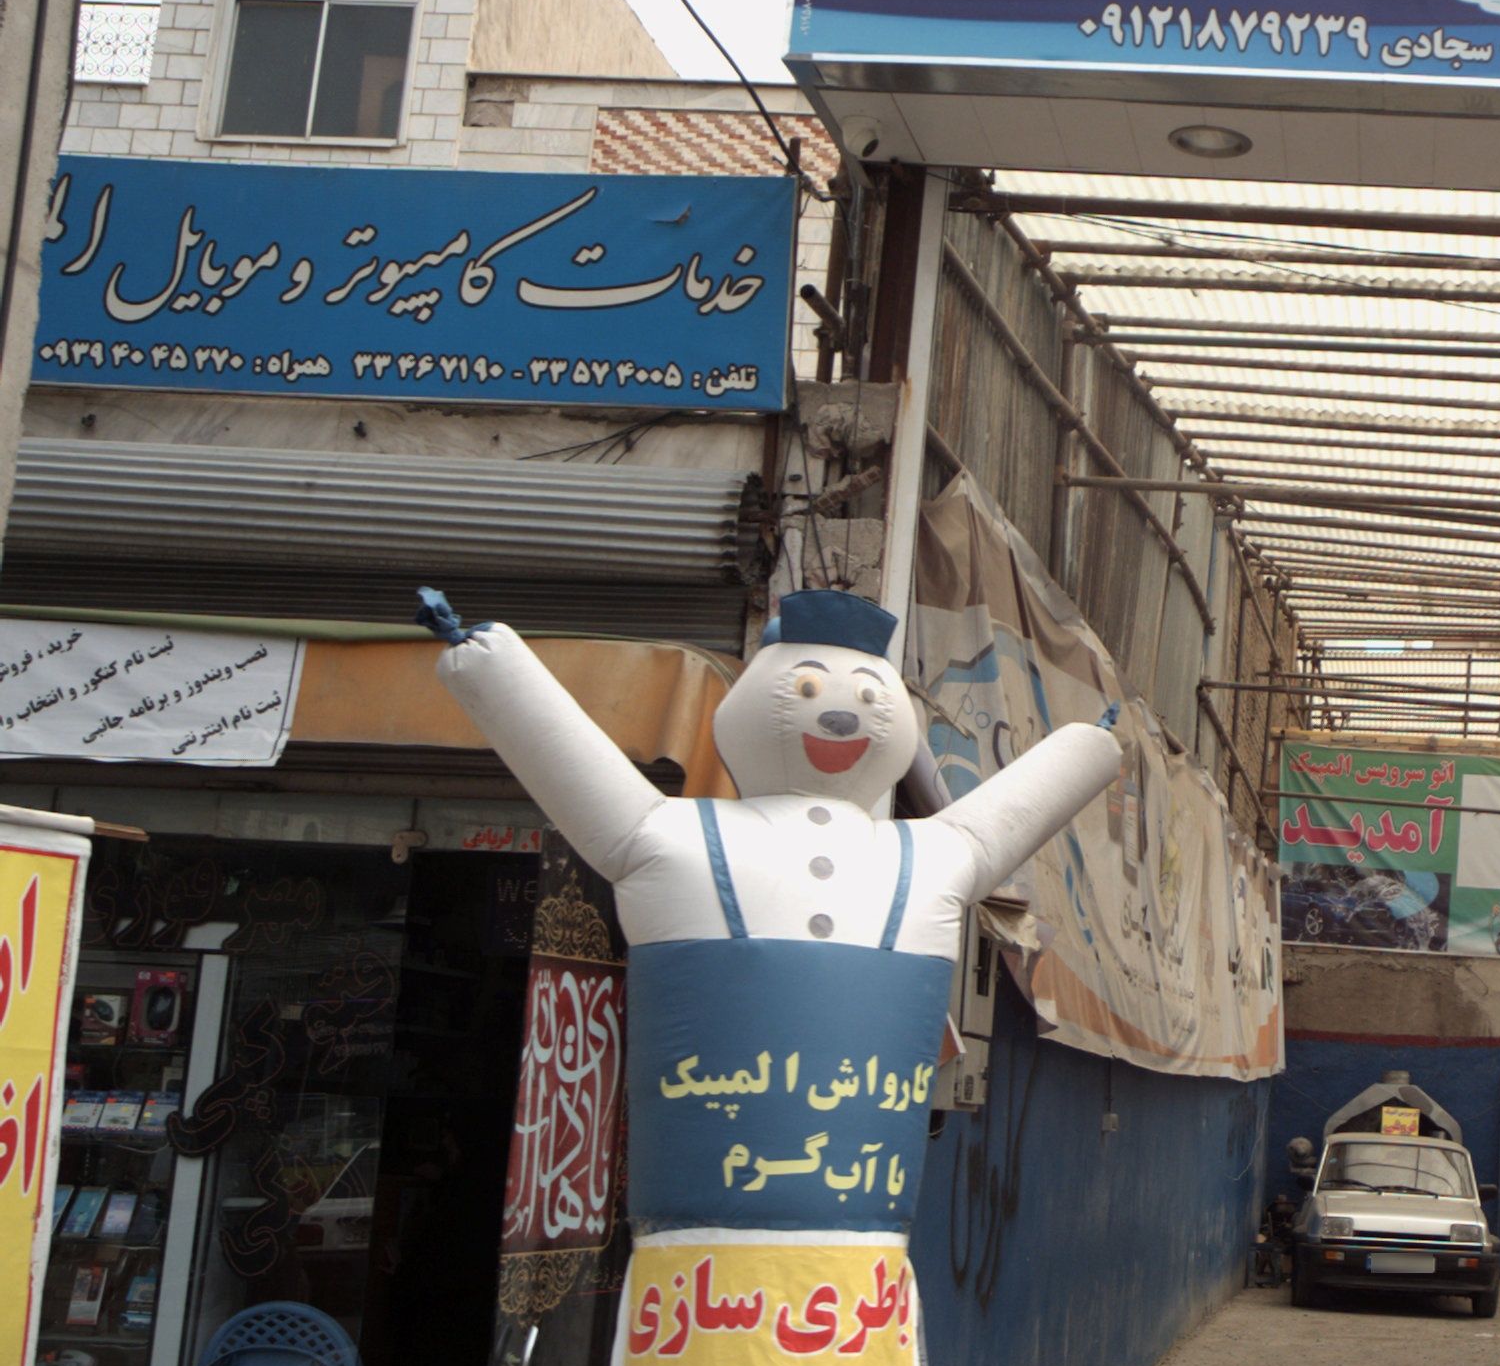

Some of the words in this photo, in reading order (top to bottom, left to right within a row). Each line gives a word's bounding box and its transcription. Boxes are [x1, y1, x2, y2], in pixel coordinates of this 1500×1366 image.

[1079, 1, 1370, 59] ۰۹۱۲۱۸۷۹۲۳۹
[1380, 27, 1493, 69] سجادی
[103, 204, 281, 325] موبایل
[324, 185, 599, 322] کامپیوتر
[280, 256, 314, 303] و
[516, 243, 765, 316] خدمات
[46, 627, 84, 656] خرید
[147, 634, 176, 660] ثبت
[234, 643, 269, 671] نصب
[81, 660, 119, 696] کنکور
[123, 652, 146, 674] نام
[68, 685, 79, 701] و
[173, 687, 183, 703] و
[186, 664, 233, 699] ویندوز
[16, 686, 65, 721] انتخاب
[128, 693, 169, 720] برنامه
[232, 706, 254, 729] نام
[254, 689, 284, 715] ثبت
[81, 713, 125, 745] جانبی
[170, 715, 229, 757] اینترنتی
[1289, 751, 1353, 784] المپیک
[1355, 762, 1426, 790] سرویس
[1428, 760, 1456, 790] اتو
[1282, 794, 1456, 864] آمدید
[806, 1054, 935, 1112] کارواش
[722, 1130, 830, 1192] گرم
[824, 1141, 885, 1203] آب
[885, 1153, 906, 1211] با
[627, 1253, 764, 1357] سازی
[776, 1257, 911, 1356] باطری
